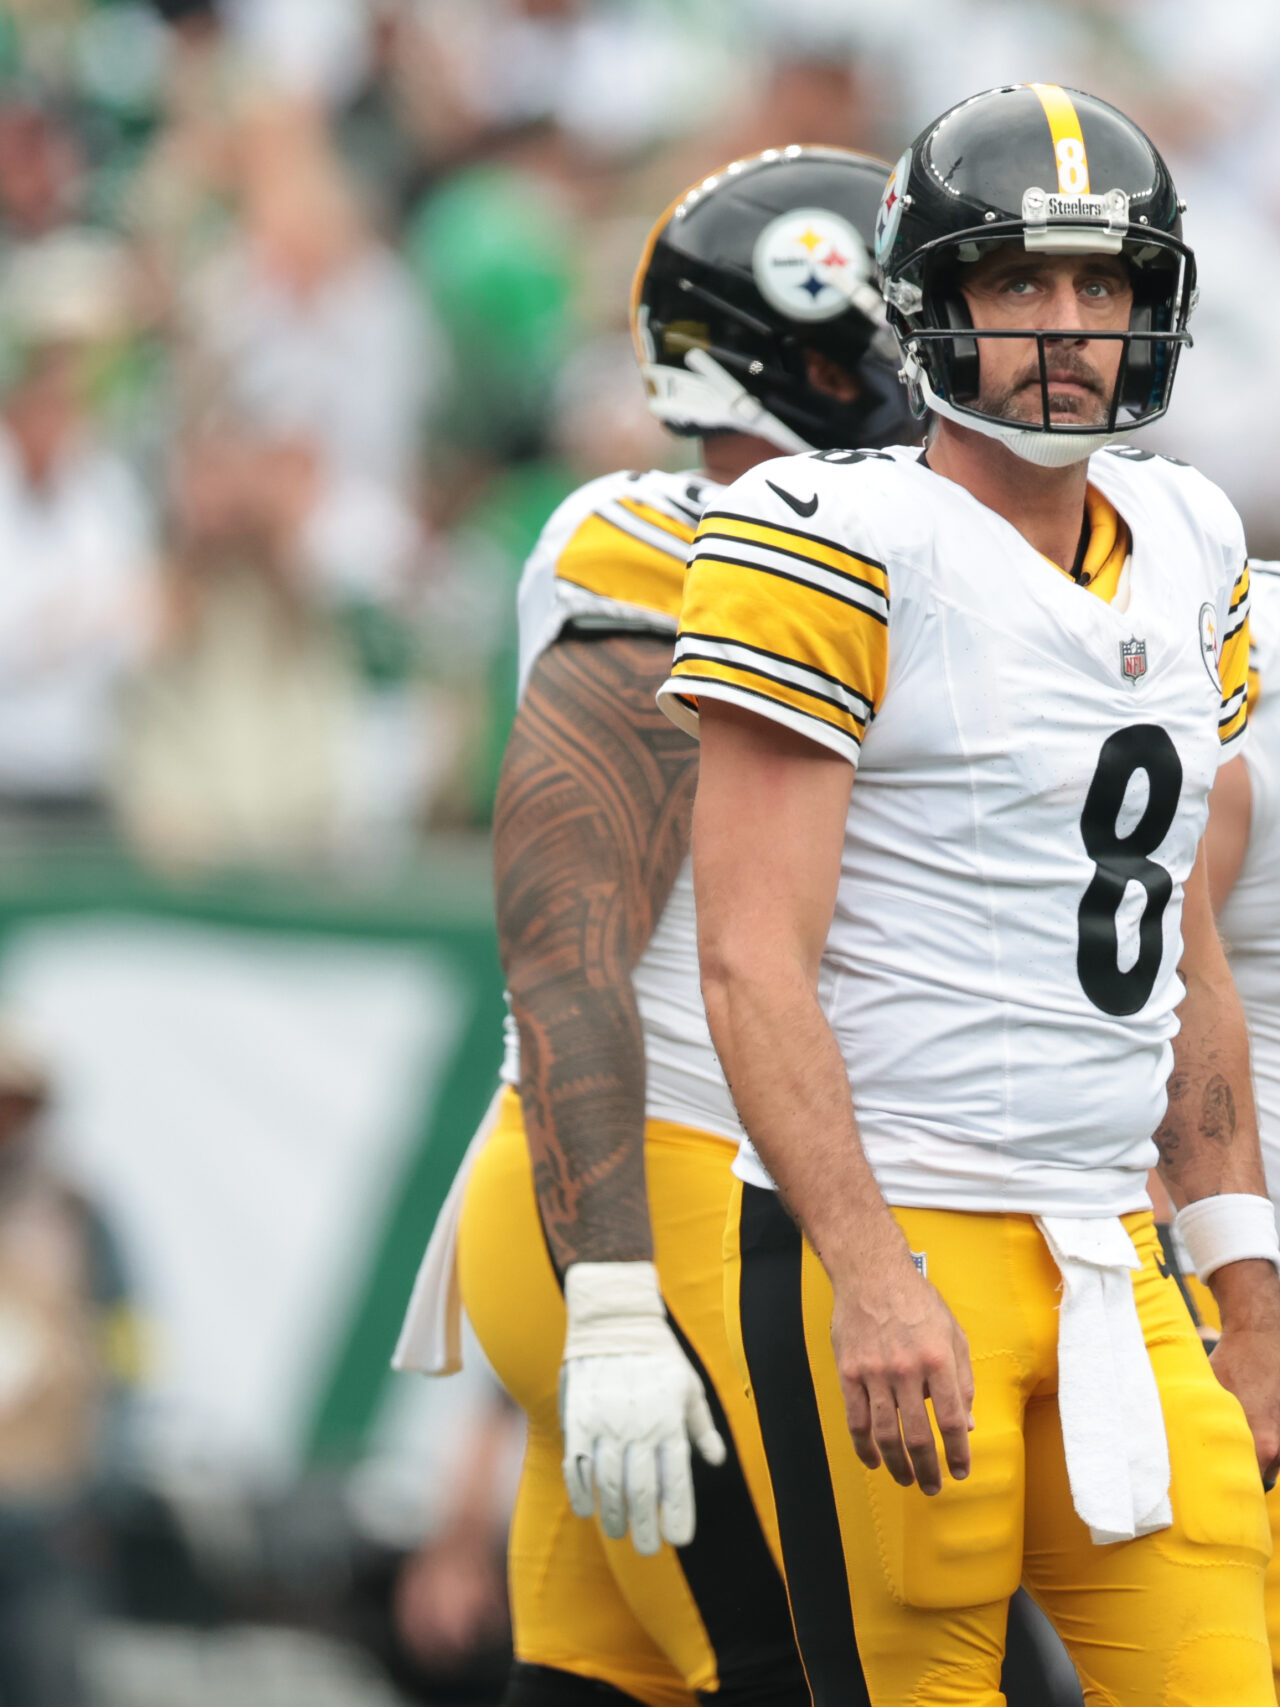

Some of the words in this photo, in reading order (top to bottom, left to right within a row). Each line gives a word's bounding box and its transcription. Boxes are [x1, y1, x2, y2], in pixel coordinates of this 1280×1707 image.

[1056, 137, 1087, 194] 8
[1048, 197, 1102, 216] Steelers
[1077, 723, 1183, 1016] 8
